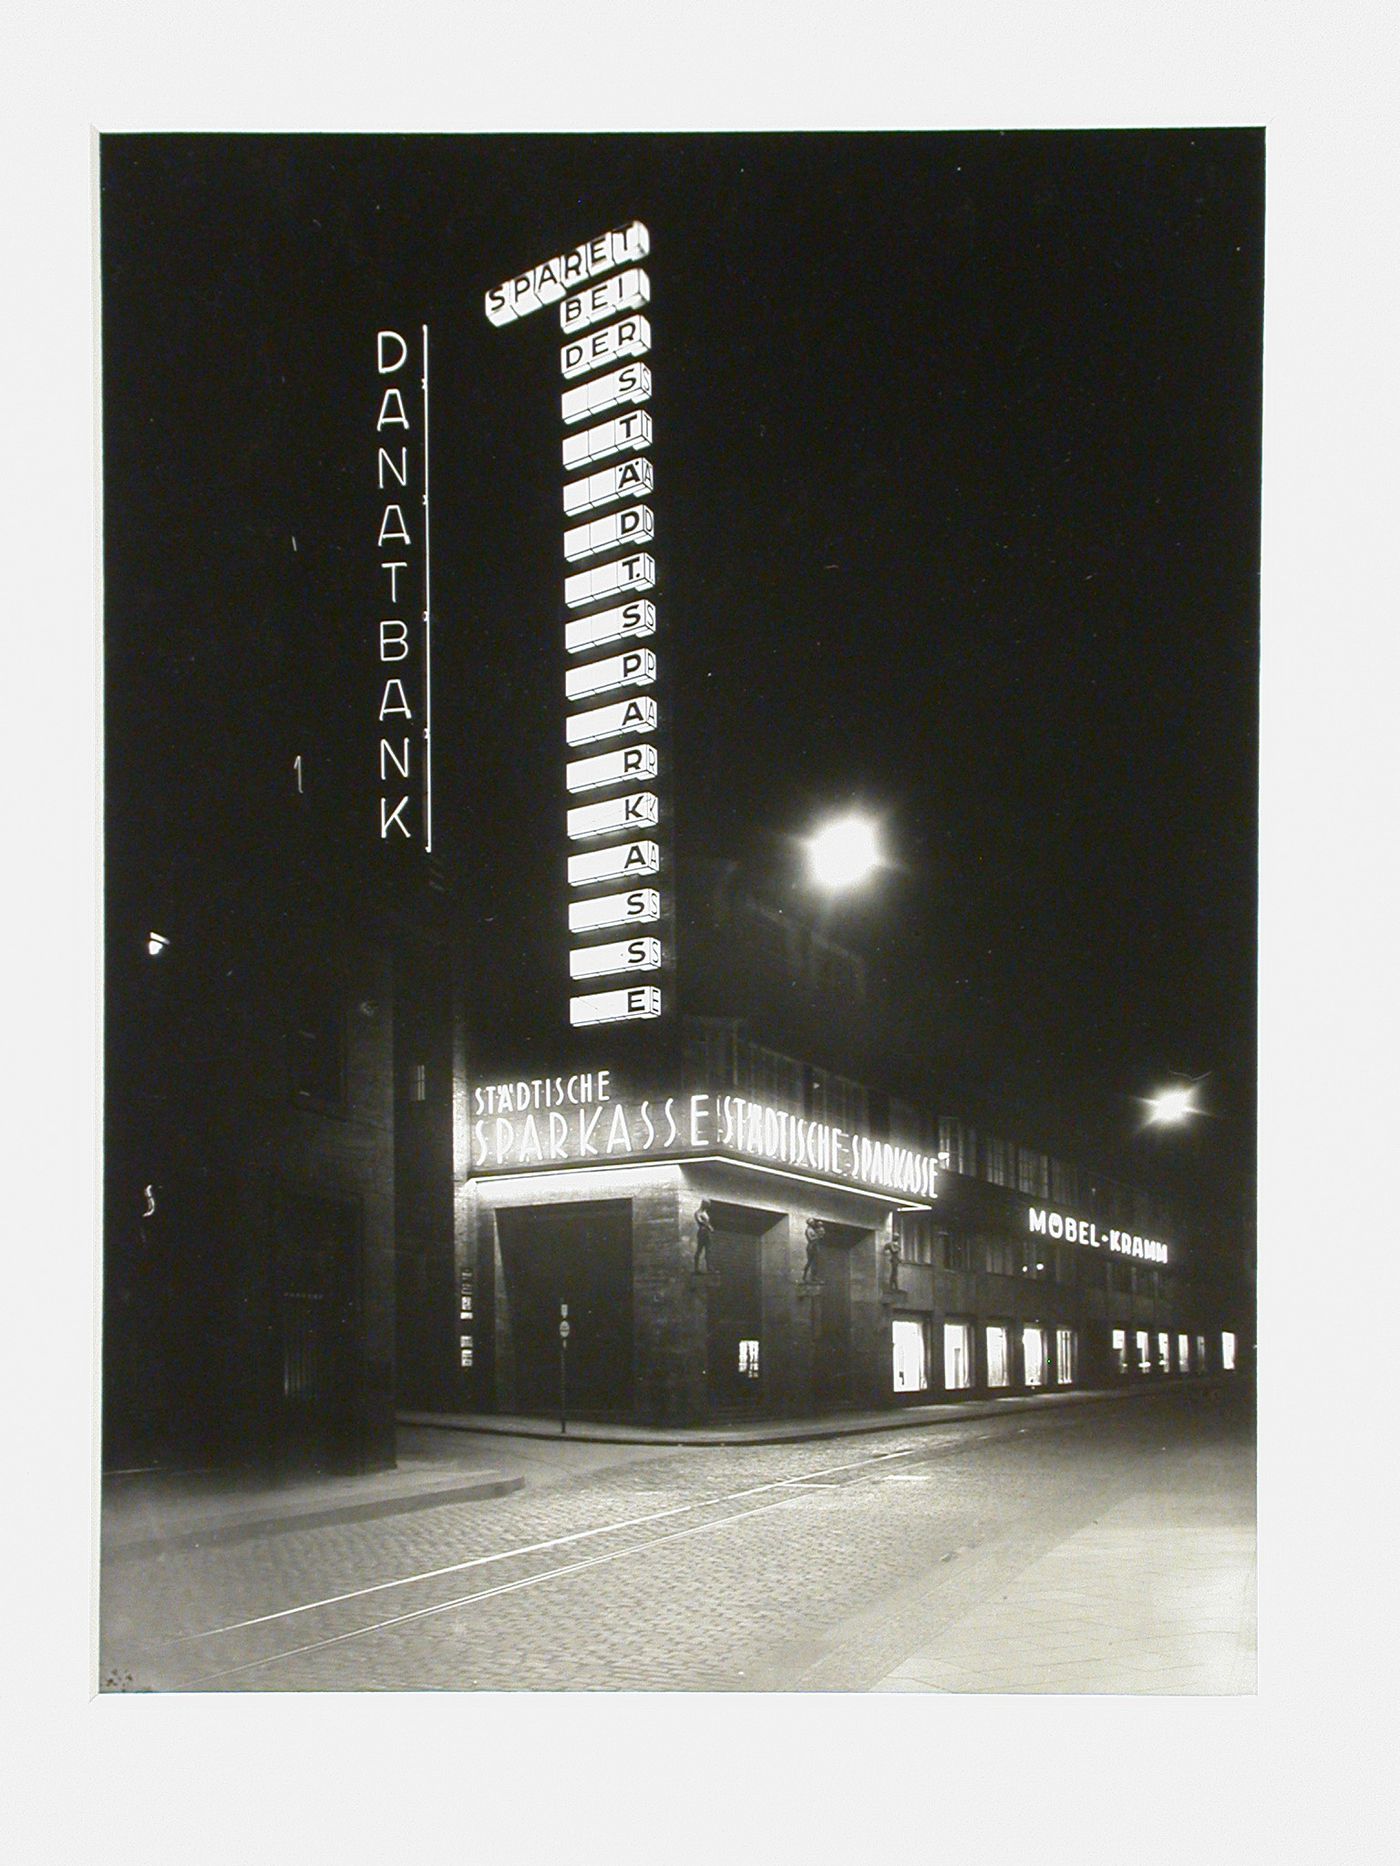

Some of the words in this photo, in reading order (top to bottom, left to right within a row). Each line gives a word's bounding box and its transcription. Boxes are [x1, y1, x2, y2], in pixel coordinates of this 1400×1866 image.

[489, 226, 634, 312] SPARET
[565, 281, 625, 322] BEI
[565, 321, 637, 367] DER
[376, 330, 412, 840] DANATBANK
[621, 605, 646, 1013] SPARKASSE
[474, 1070, 611, 1116] STÄDTISCHE
[474, 1094, 710, 1166] SPARKASSE
[721, 1095, 844, 1175] STÄDTISCHE
[851, 1134, 939, 1199] SPARKASSE
